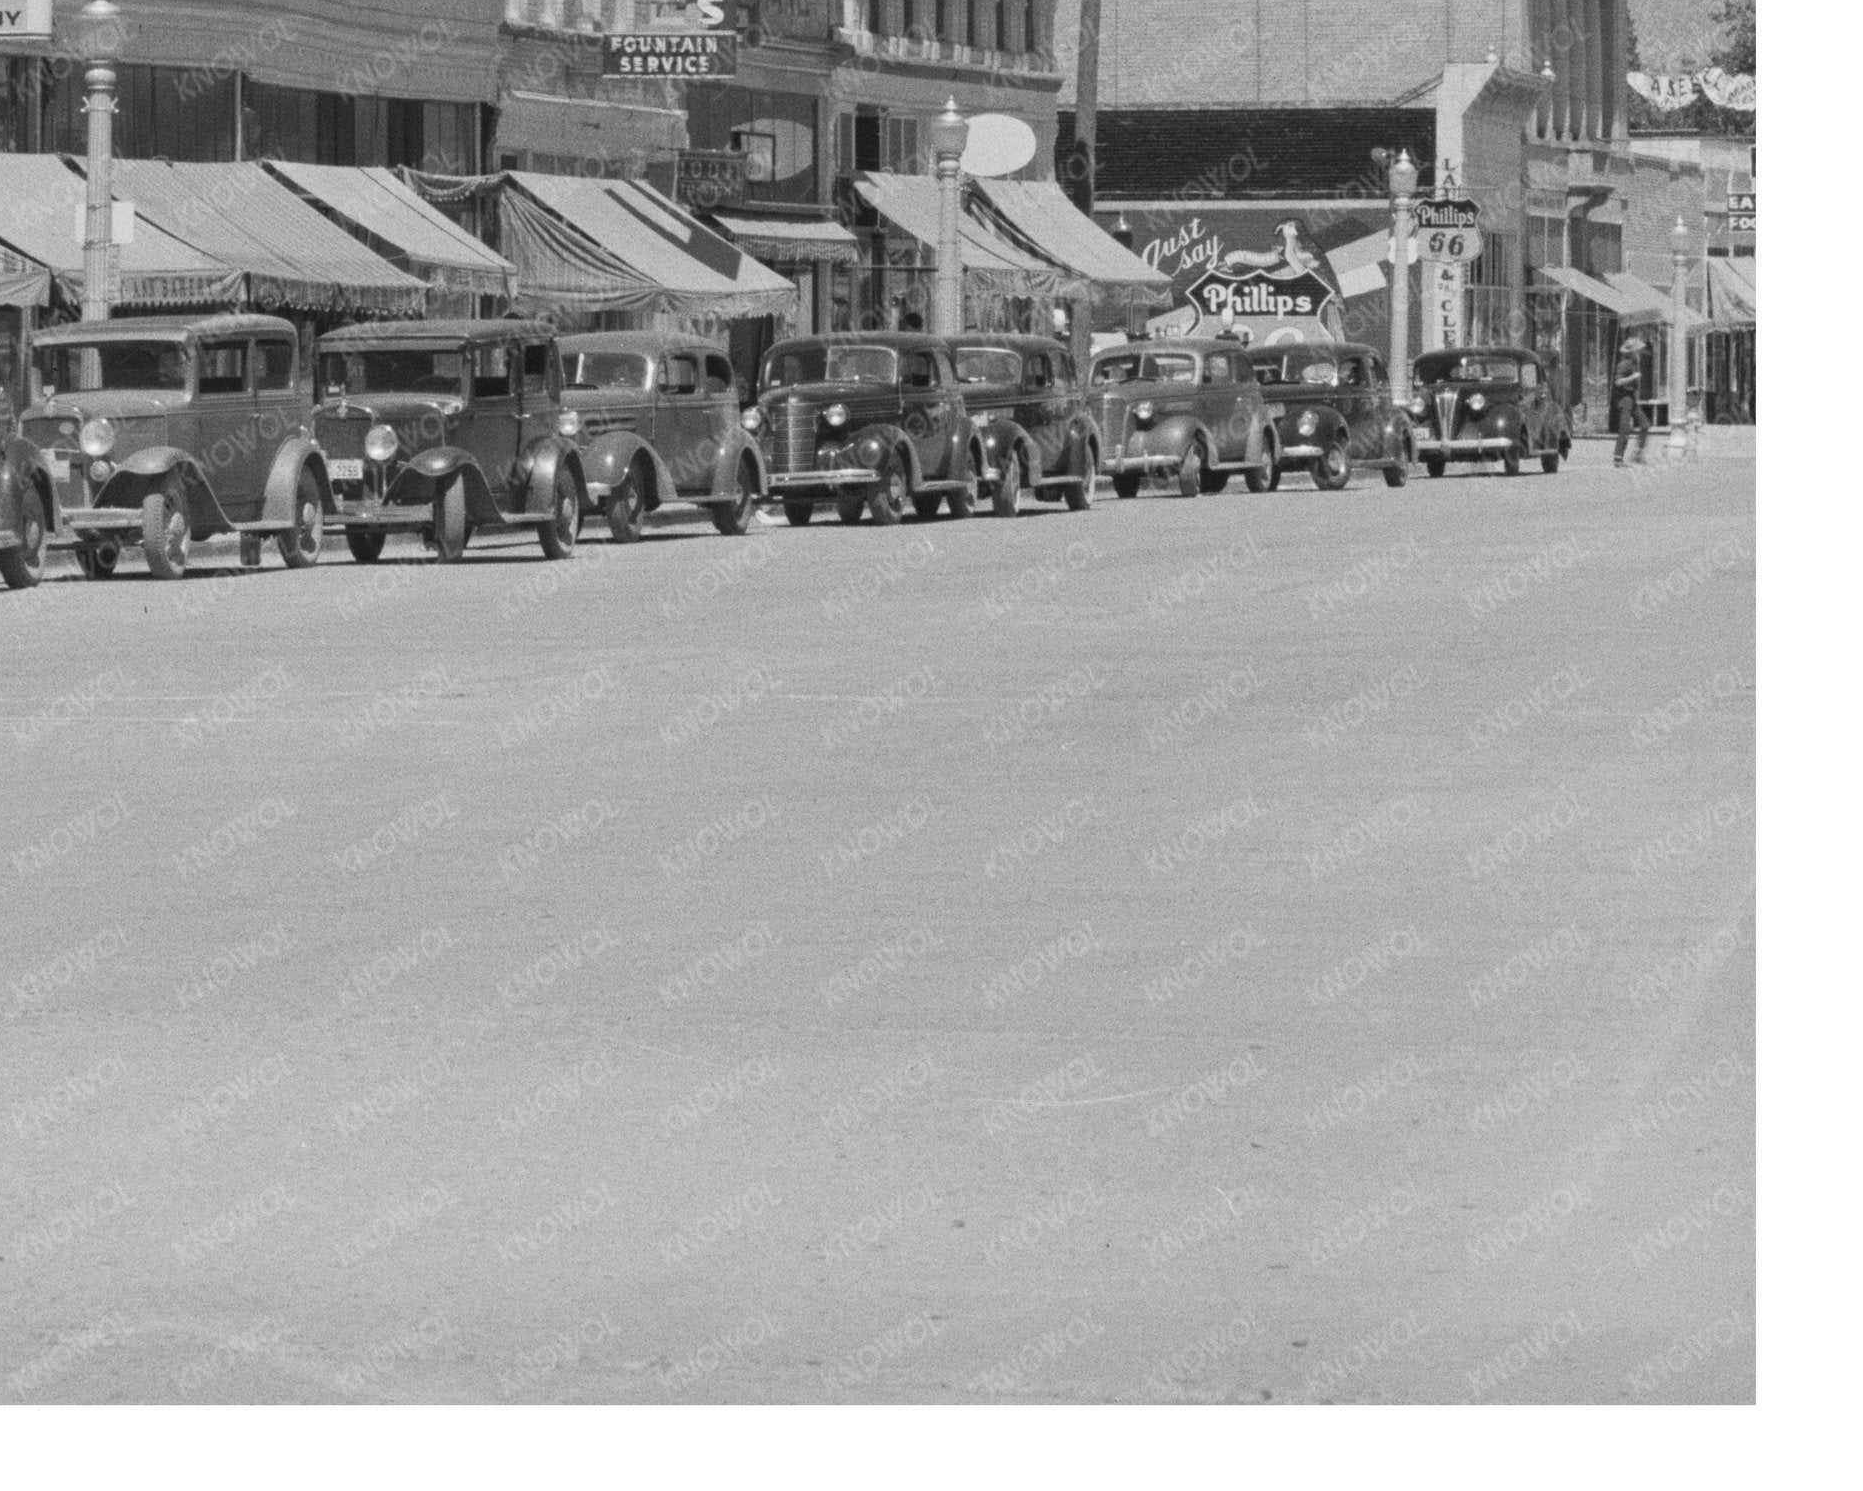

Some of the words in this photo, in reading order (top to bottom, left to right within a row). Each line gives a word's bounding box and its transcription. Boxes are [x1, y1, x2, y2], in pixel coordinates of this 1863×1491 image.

[610, 36, 718, 53] FOUNTAIN
[619, 55, 710, 74] SERVICE
[1417, 204, 1475, 230] Phillips
[1141, 216, 1207, 271] Just
[1171, 235, 1225, 277] say
[1429, 231, 1464, 257] 66
[1441, 268, 1455, 282] &
[1202, 282, 1313, 321] Phillips
